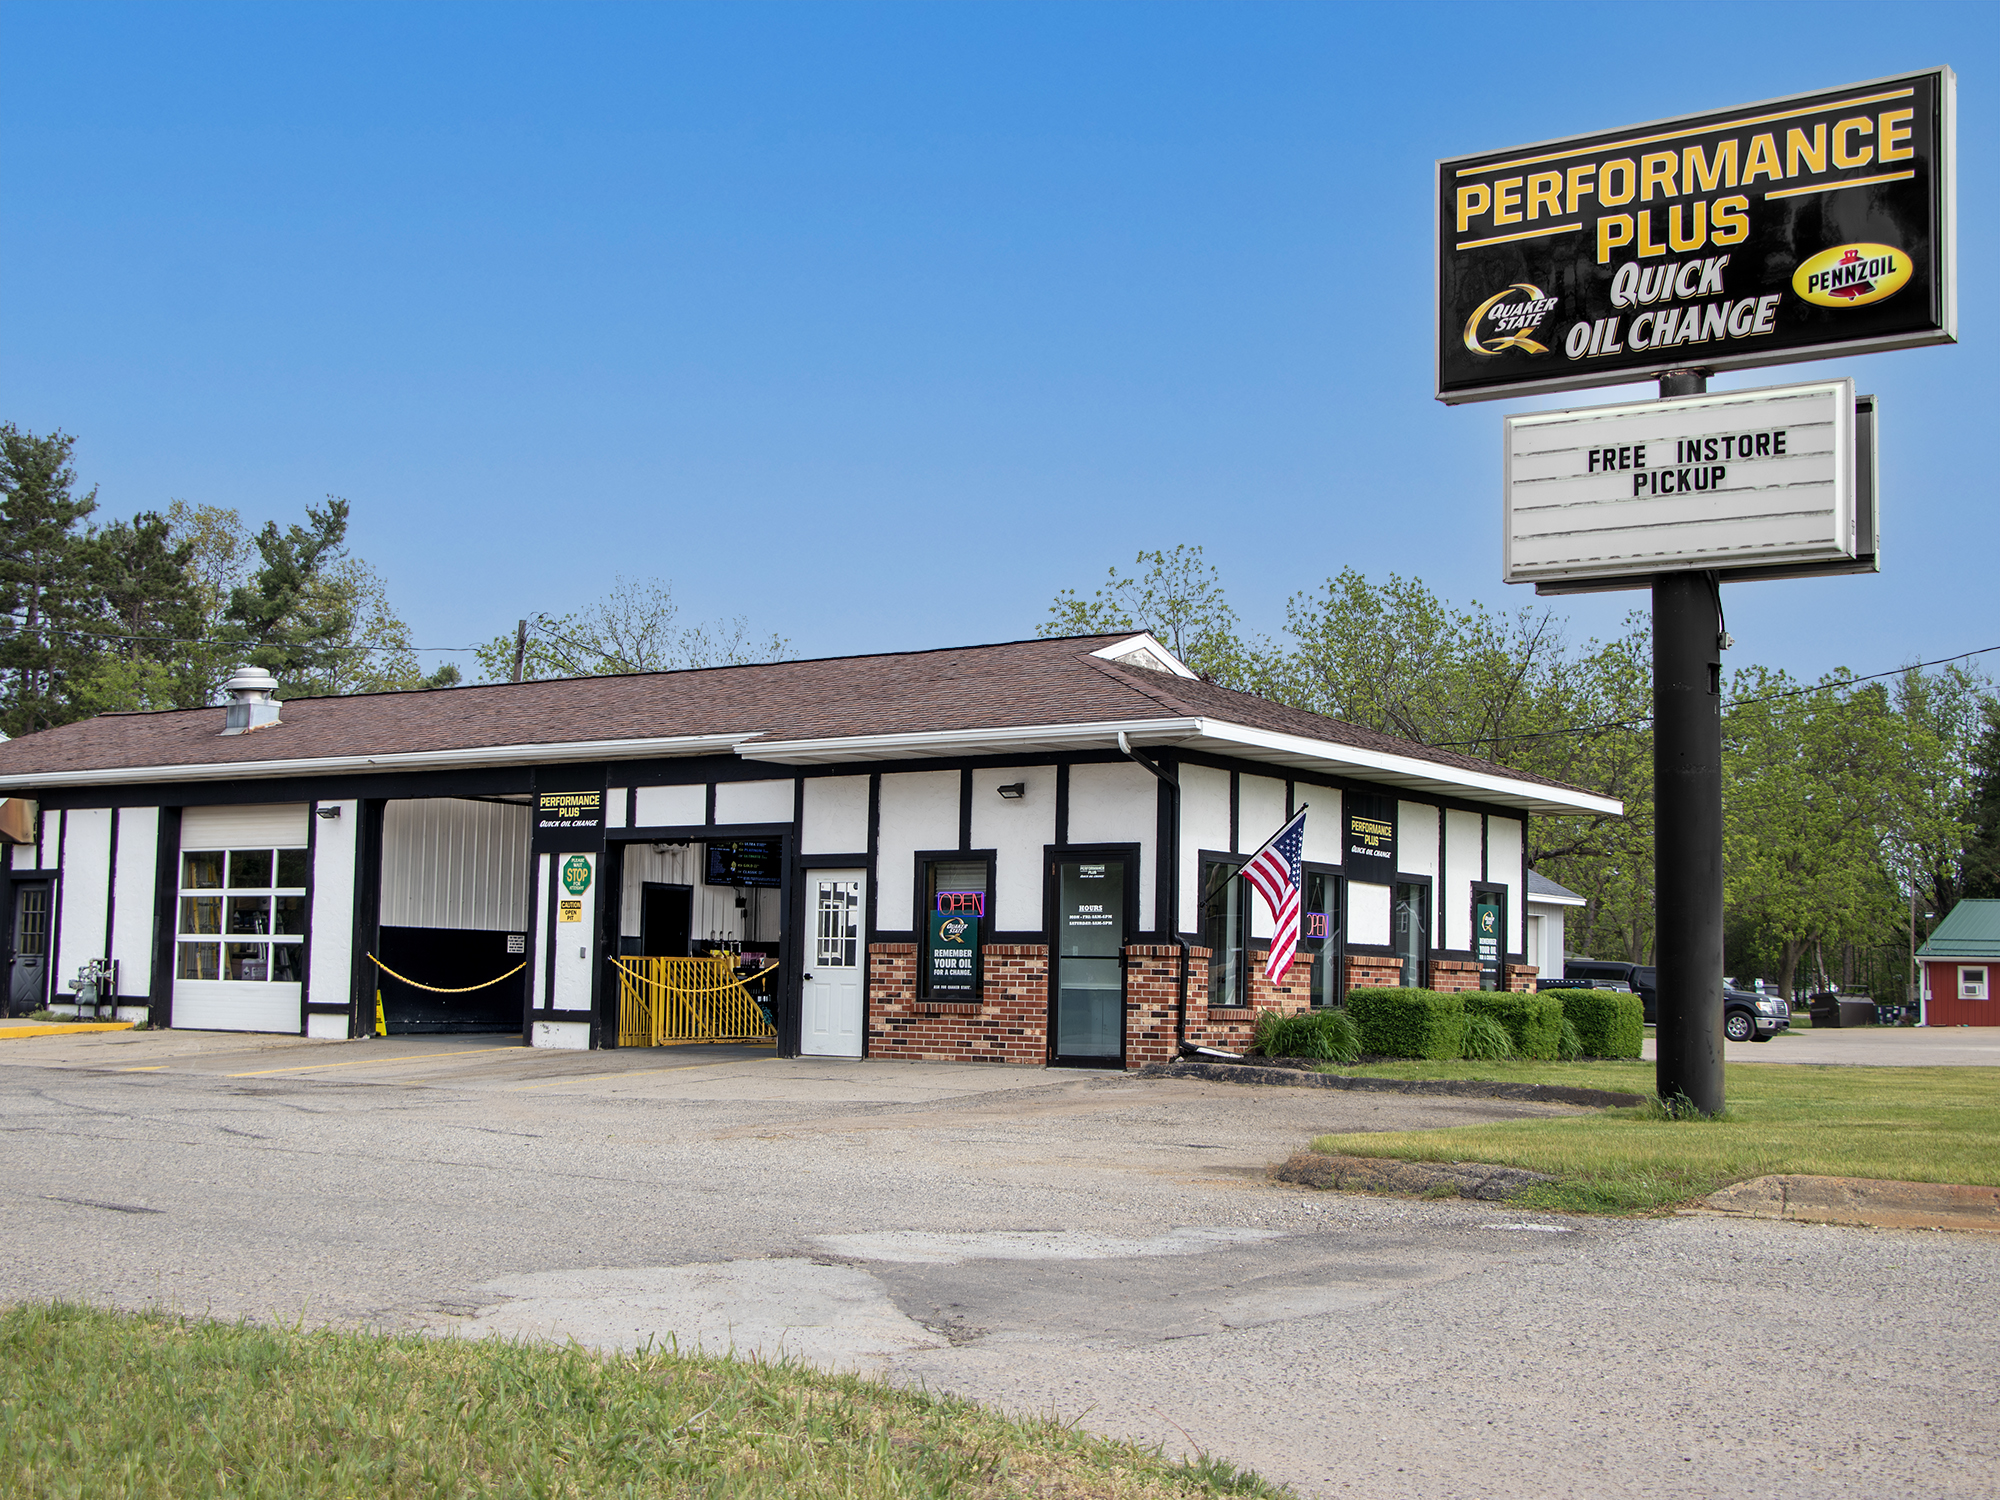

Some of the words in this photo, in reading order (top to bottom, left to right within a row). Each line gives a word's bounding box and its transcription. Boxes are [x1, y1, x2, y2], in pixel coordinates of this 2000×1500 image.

[1456, 107, 1914, 232] PERFORMANCE
[1597, 194, 1749, 264] PLUS
[1610, 254, 1731, 309] QUICK
[1808, 255, 1897, 294] PENNZOIL
[1488, 297, 1558, 320] QUAKER
[1494, 312, 1546, 332] STATE
[1565, 316, 1623, 360] OIL
[1628, 293, 1782, 352] CHANGE
[1588, 445, 1646, 473] FREE
[1677, 431, 1786, 463] INSTORE
[1633, 465, 1726, 496] PICKUP
[540, 795, 600, 807] PERFORMANCE
[559, 807, 580, 817] PLUS
[1351, 820, 1392, 837] PERFORMANCE
[1364, 834, 1379, 847] PLUS
[566, 868, 588, 882] STOP
[939, 893, 984, 915] OPEN
[934, 949, 972, 957] REMEMBER
[934, 958, 957, 968] YOUR
[959, 958, 972, 968] OIL
